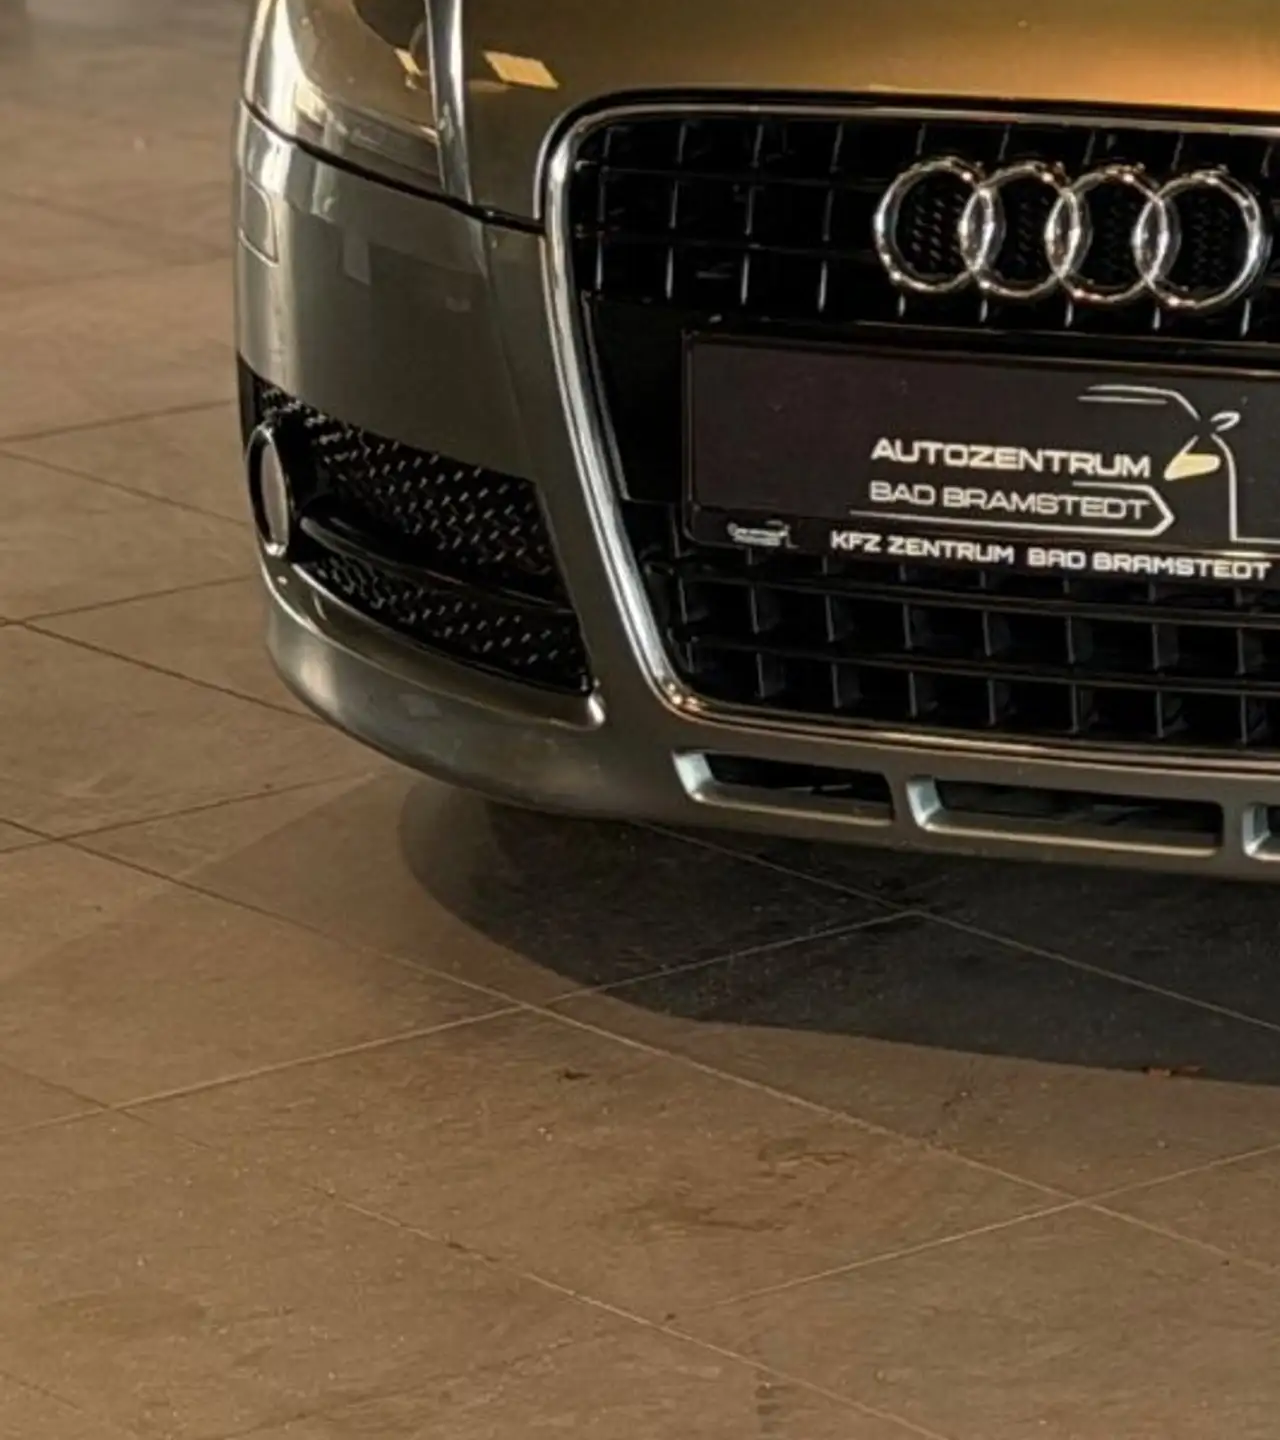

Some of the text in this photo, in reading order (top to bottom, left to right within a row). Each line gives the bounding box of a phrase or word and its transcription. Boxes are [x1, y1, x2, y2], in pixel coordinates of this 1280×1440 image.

[870, 437, 1150, 478] AUTOZENTRUM
[869, 480, 1150, 520] BAD BRAMSTEDT
[830, 529, 1271, 581] KFZ ZENTRUM BAD BRAMSTEDT
